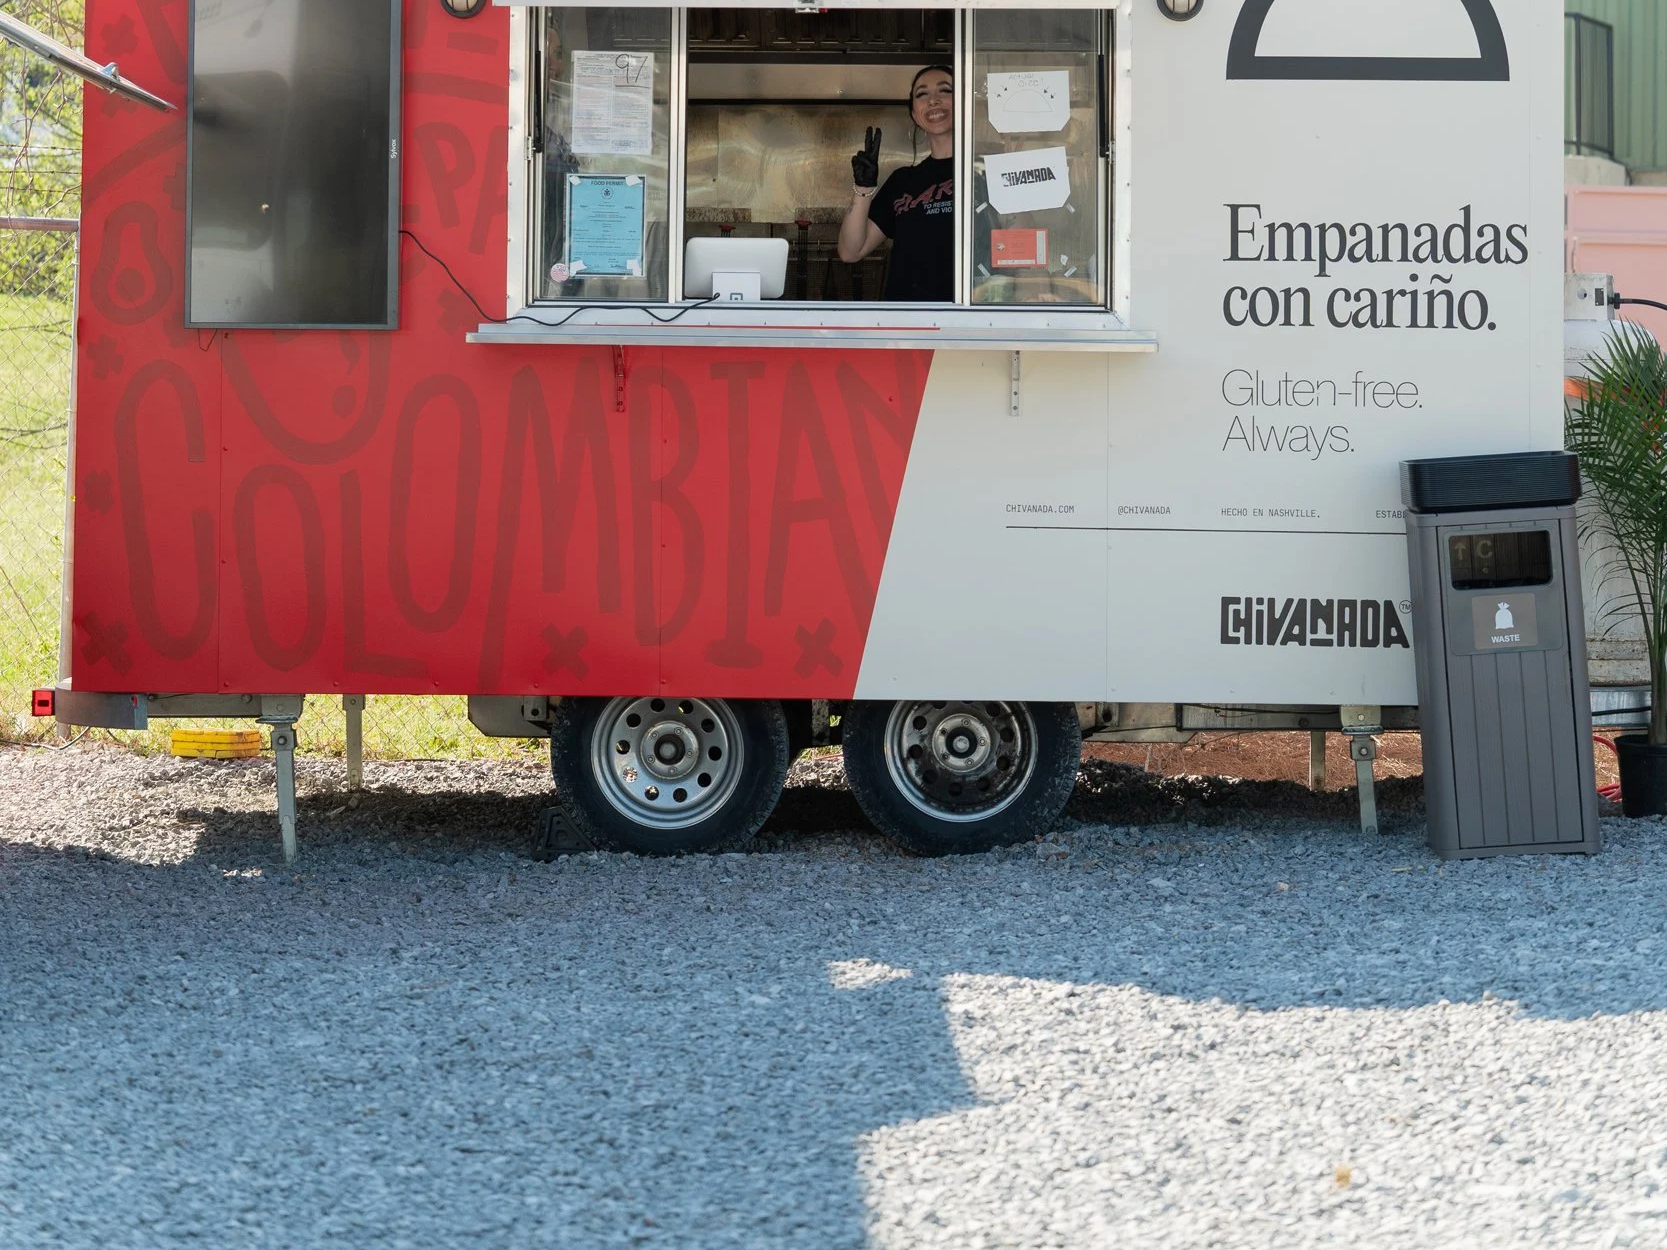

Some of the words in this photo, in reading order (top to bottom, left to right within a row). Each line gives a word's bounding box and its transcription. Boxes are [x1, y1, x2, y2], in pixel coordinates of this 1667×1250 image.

[615, 53, 648, 84] 97
[390, 138, 398, 159] Sylvox
[1222, 203, 1529, 277] Empanadas
[1222, 285, 1315, 328] con
[1326, 273, 1497, 331] cariño.
[1221, 368, 1423, 409] Gluten-free.
[1222, 414, 1354, 461] Always.
[1005, 504, 1075, 514] CHIVANADA.COM
[1117, 505, 1171, 515] @CHIVANADA
[1221, 508, 1248, 517] HECHO
[1252, 509, 1264, 517] EN
[1491, 634, 1520, 643] WASTE
